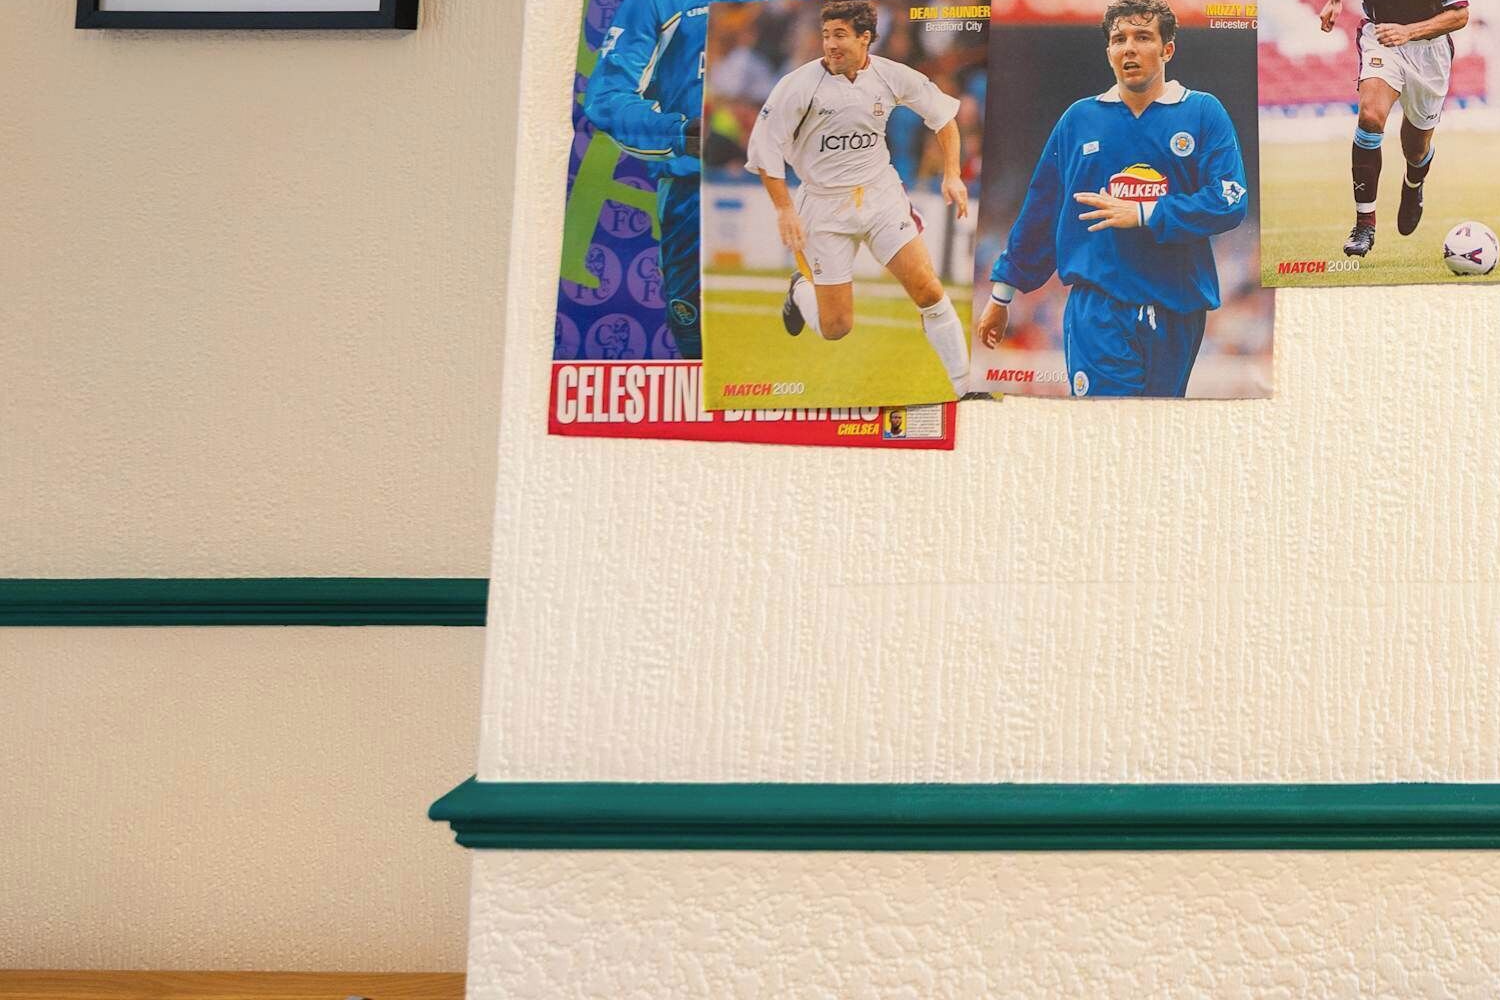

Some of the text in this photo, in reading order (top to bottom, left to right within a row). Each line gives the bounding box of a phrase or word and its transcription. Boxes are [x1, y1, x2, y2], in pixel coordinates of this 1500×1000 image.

[910, 5, 991, 20] DEAN SAUNDER
[1206, 4, 1242, 17] MUZZY
[925, 20, 983, 33] Bradford City
[1210, 19, 1249, 29] Leicester
[1110, 181, 1167, 199] WALKERS
[1278, 259, 1360, 275] MATCH 2000
[986, 369, 1034, 382] MATCH
[724, 381, 805, 396] MATCH 2000
[837, 422, 880, 436] CHELSEA
